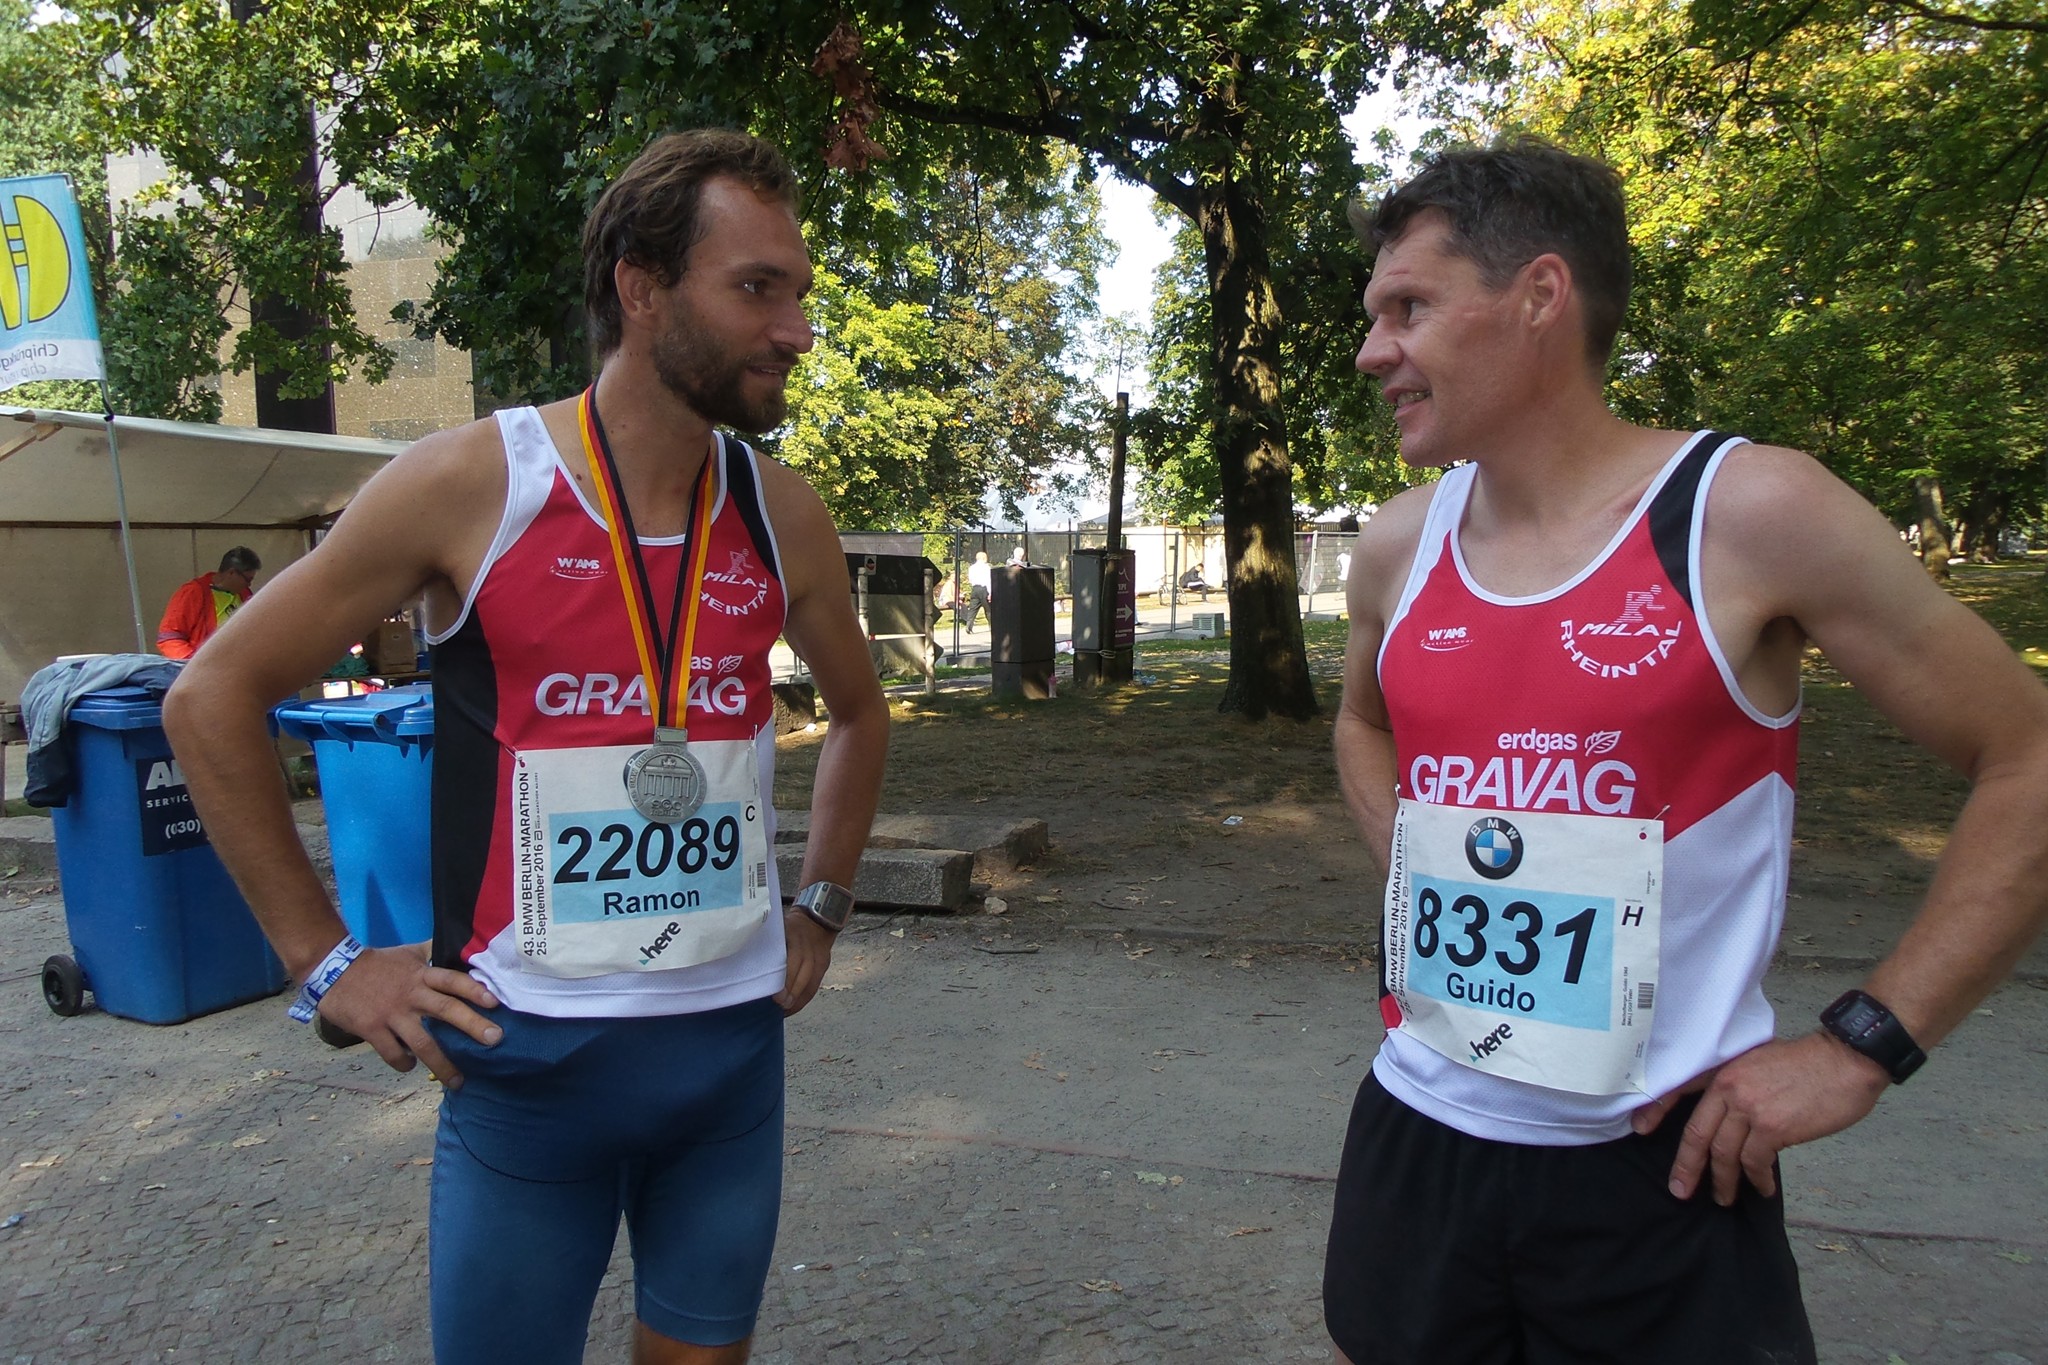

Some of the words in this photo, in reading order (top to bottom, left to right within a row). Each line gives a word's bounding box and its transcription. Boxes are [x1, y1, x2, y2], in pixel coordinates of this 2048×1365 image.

[700, 577, 768, 616] HEINTAL
[1560, 619, 1682, 679] RHEINTAL
[535, 672, 747, 716] GRAAG
[1497, 727, 1578, 755] erdgas
[146, 794, 190, 808] SERVIC
[1410, 754, 1637, 815] GRAVAG
[165, 818, 201, 840] (030)
[745, 804, 756, 822] C
[1469, 818, 1519, 841] BMW
[519, 772, 533, 900] BERLIN-MARATHON
[553, 815, 741, 885] 22089
[533, 844, 544, 872] 2016
[535, 874, 548, 936] September
[603, 889, 700, 916] Ramon
[1389, 823, 1403, 957] BERLIN-MARATHON
[522, 902, 534, 935] BMW
[1399, 900, 1409, 931] 2016
[1621, 905, 1643, 928] H
[523, 937, 535, 957] 43.
[536, 937, 547, 956] 25.
[640, 921, 682, 960] here
[1413, 887, 1598, 985] 8331
[1389, 958, 1398, 993] BMW
[1397, 931, 1406, 997] September
[1446, 972, 1536, 1013] Guido
[1470, 1020, 1514, 1060] here
